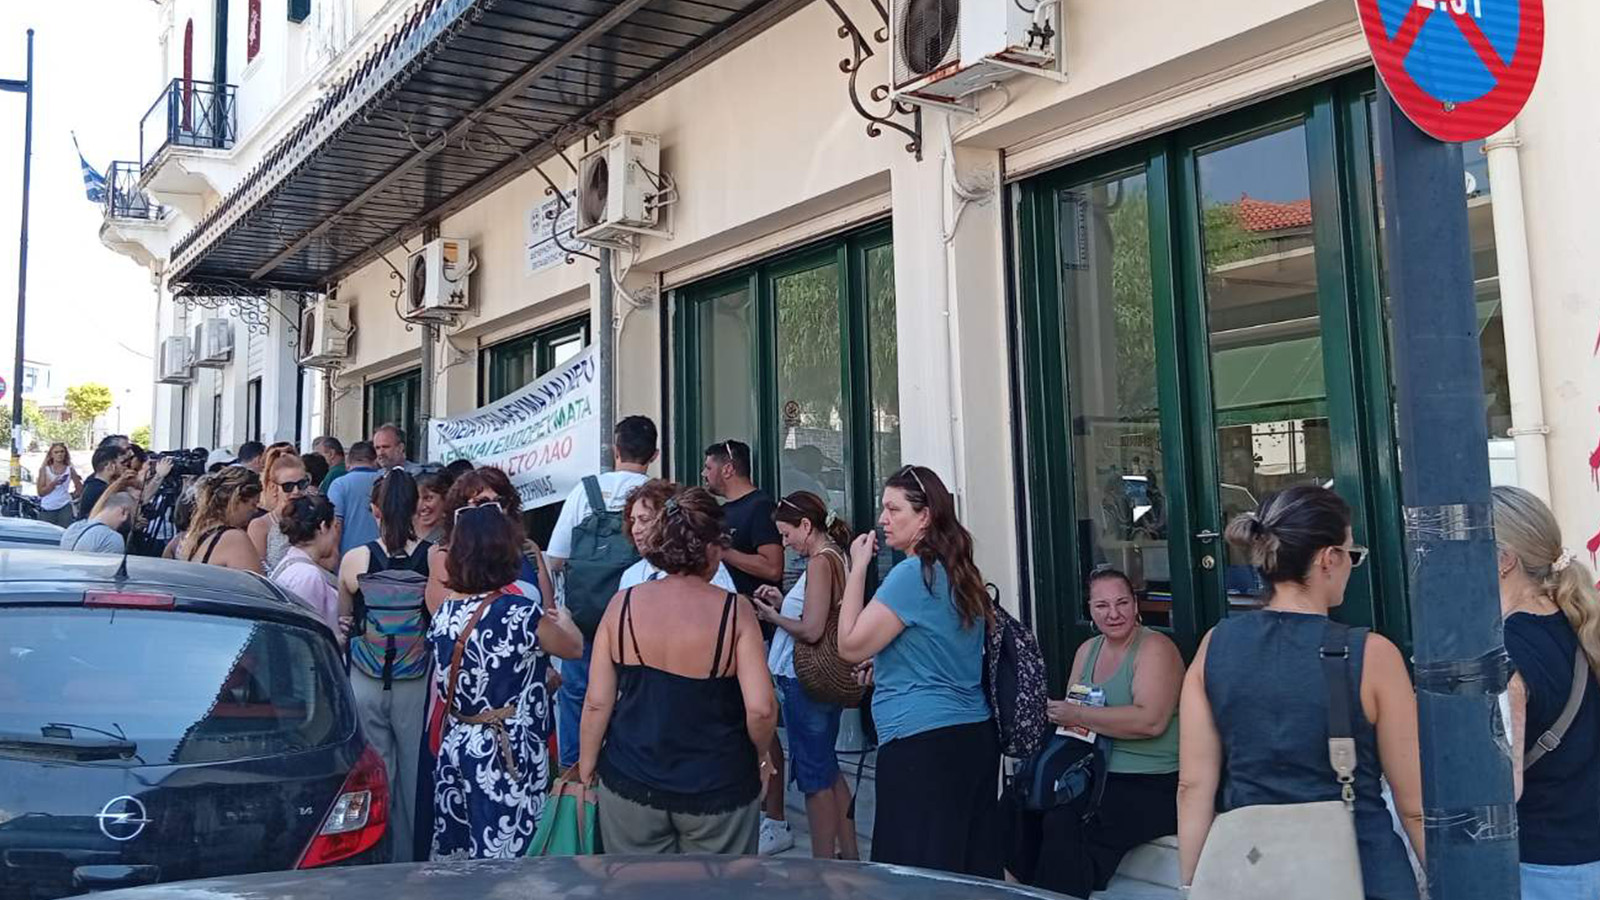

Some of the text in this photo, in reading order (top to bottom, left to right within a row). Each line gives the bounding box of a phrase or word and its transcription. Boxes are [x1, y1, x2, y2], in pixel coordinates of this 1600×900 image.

[537, 377, 565, 405] ΚΑΙ
[508, 449, 538, 477] ΣΤΟ
[538, 435, 573, 467] ΛΑΟ
